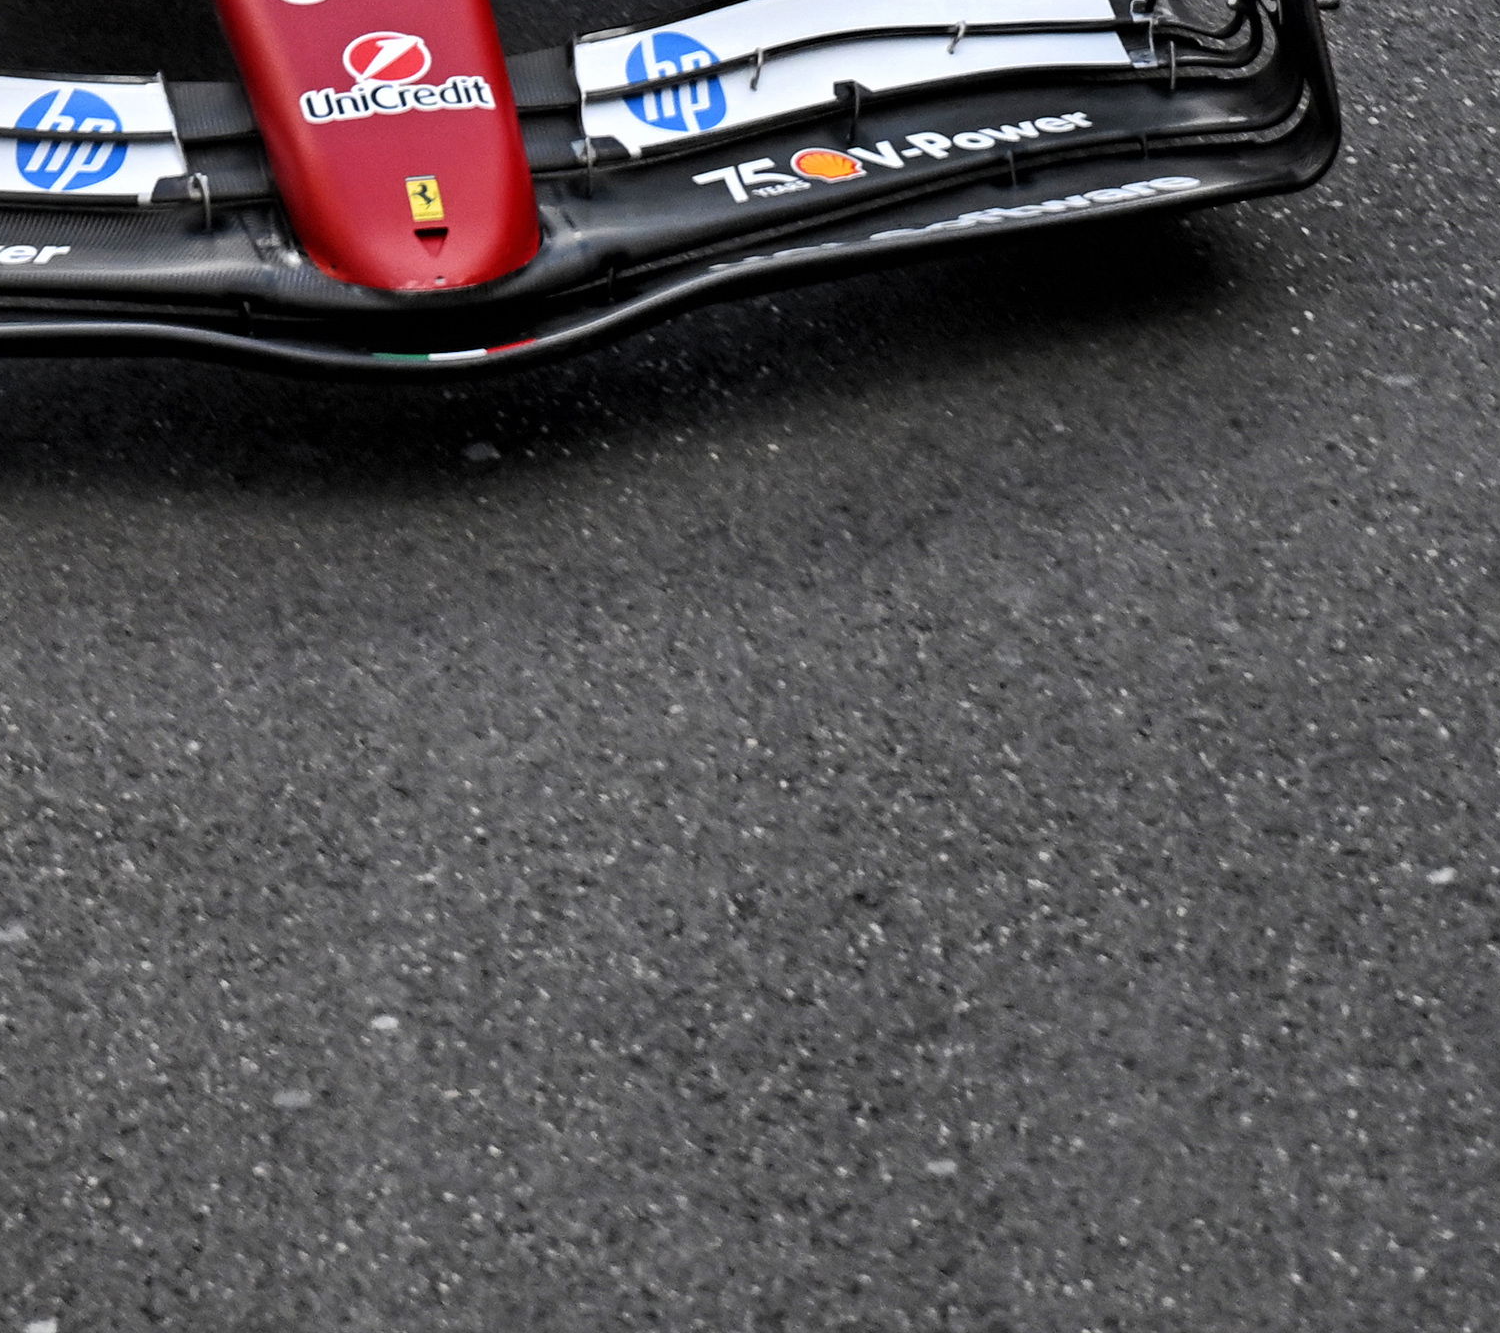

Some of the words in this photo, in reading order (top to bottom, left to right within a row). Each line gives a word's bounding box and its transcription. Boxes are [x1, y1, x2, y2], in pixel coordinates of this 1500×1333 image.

[304, 77, 493, 121] UniCredit
[642, 32, 717, 132] hp
[21, 88, 116, 190] hp
[847, 110, 1093, 169] V-Power
